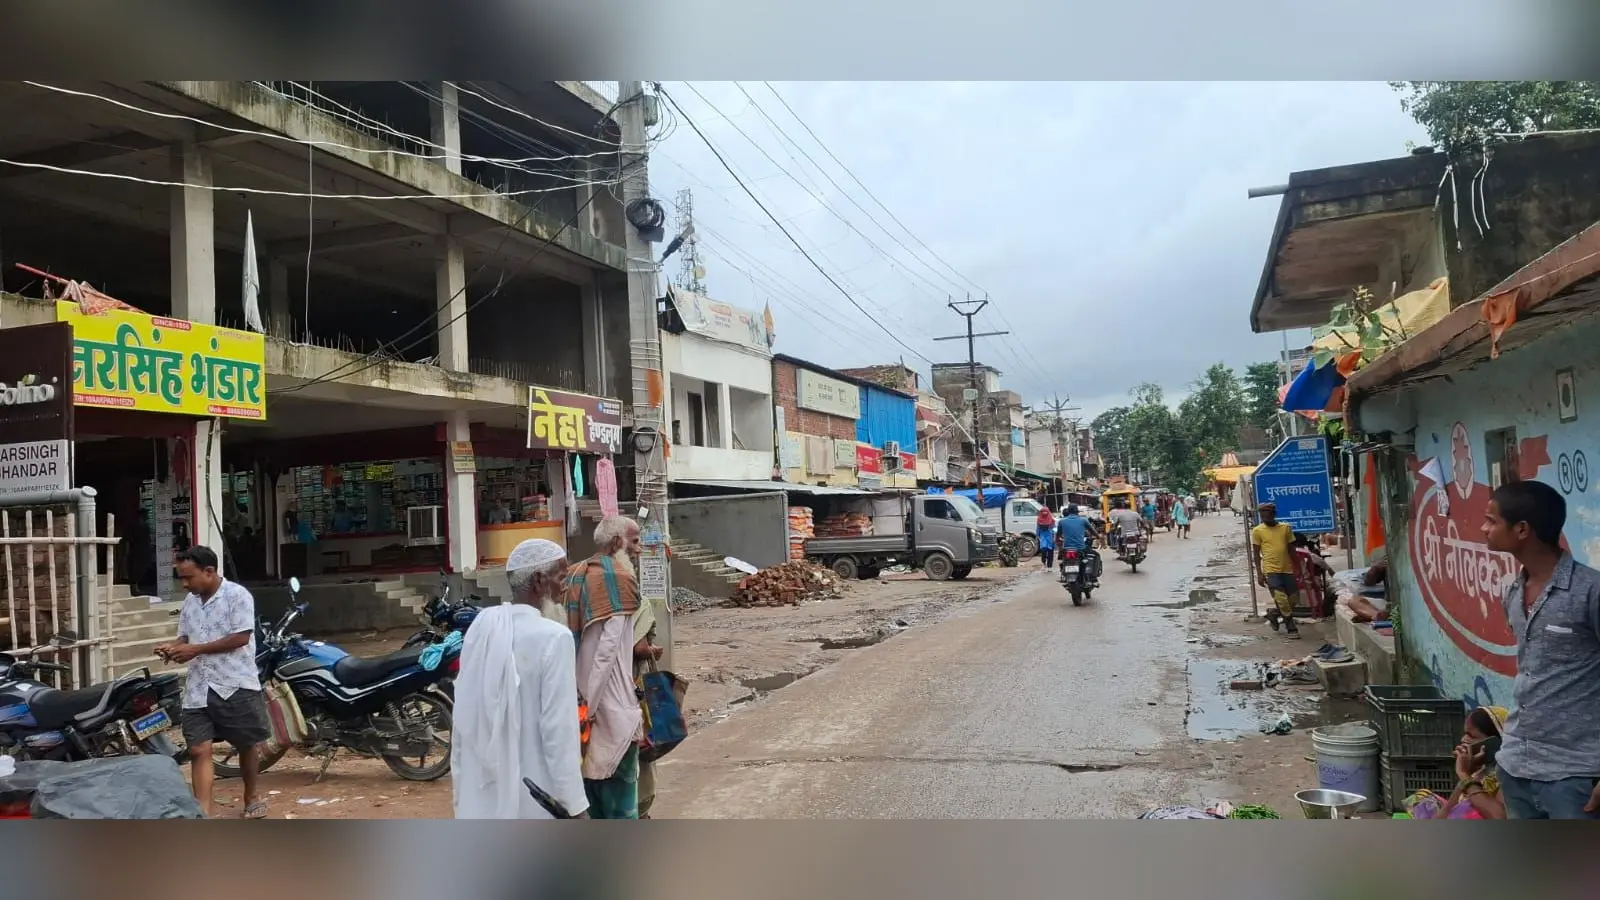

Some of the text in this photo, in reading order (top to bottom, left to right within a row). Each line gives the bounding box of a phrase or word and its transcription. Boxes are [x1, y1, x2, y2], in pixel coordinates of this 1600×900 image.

[73, 323, 262, 405] नरसिंह भंडार
[532, 389, 587, 448] नेहा
[0, 444, 59, 461] ARSINGH
[0, 462, 57, 479] HANDAR
[1265, 484, 1320, 501] पुस्तकालय
[1424, 515, 1443, 583] श्री
